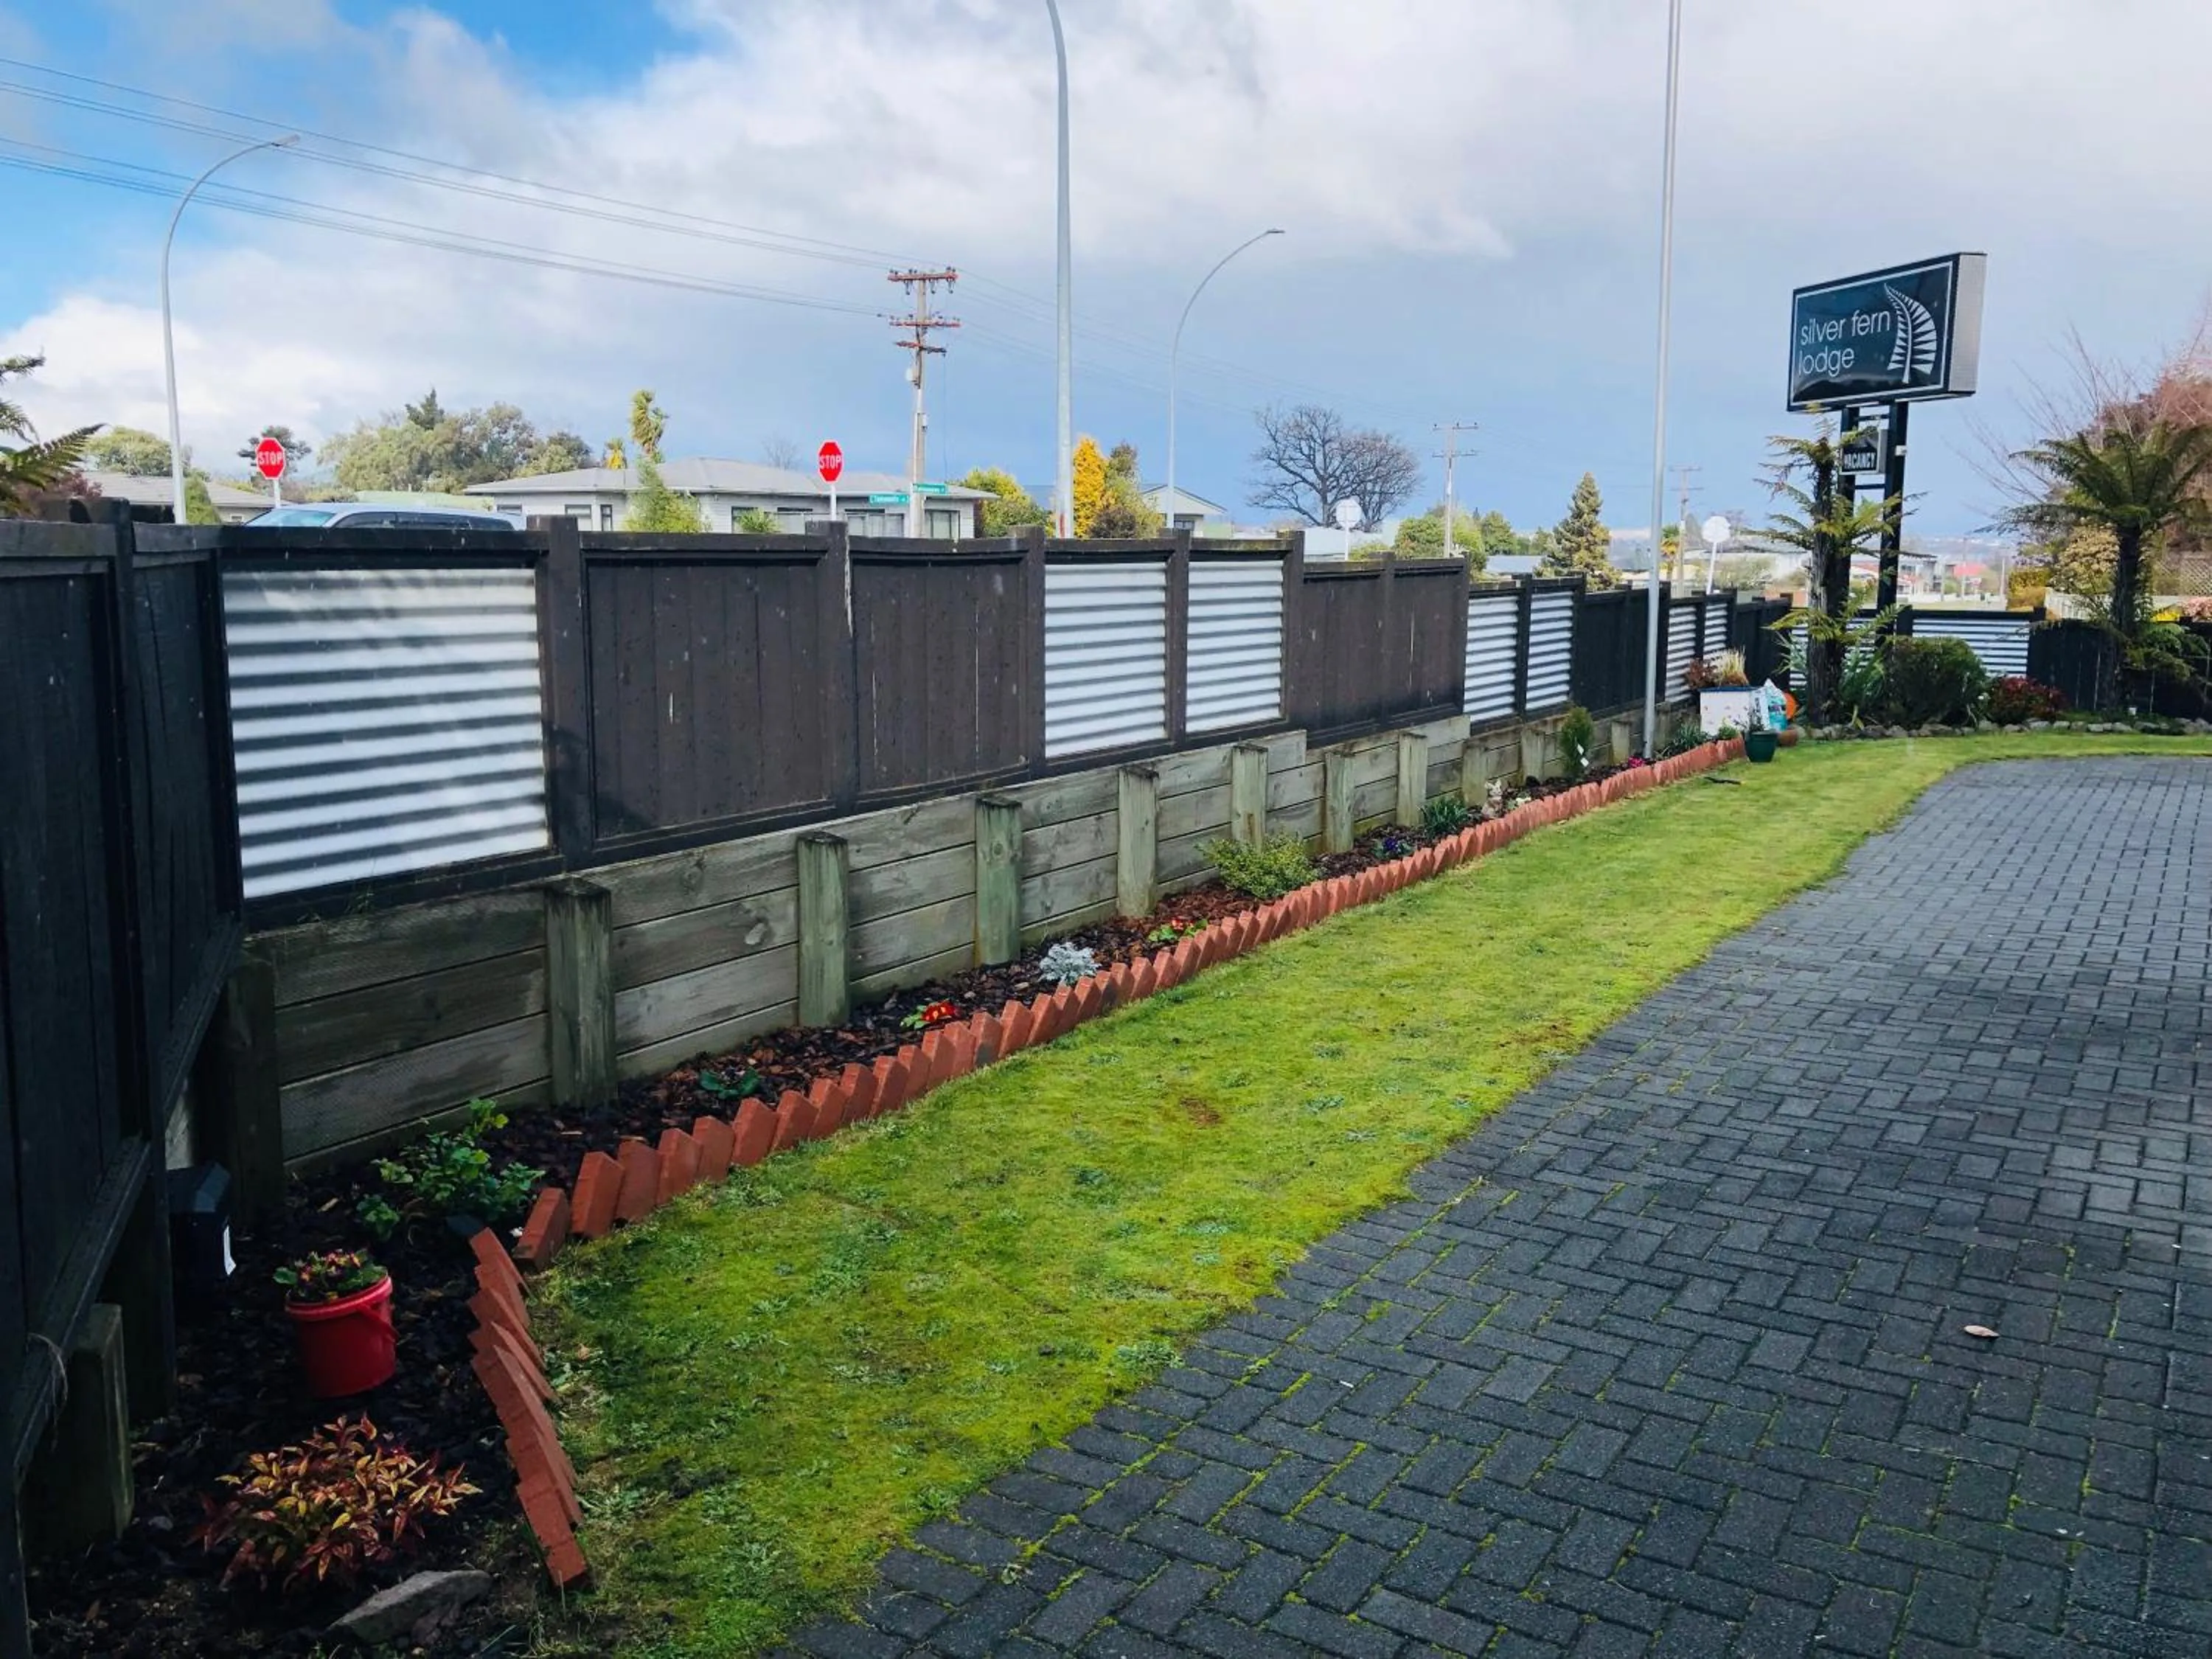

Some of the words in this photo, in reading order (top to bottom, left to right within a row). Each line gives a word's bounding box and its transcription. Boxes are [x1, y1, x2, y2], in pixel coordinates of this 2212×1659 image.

[1800, 318, 1846, 346] silver
[1851, 310, 1890, 337] fern
[1798, 346, 1854, 378] lodge
[259, 451, 283, 465] STOP
[819, 454, 841, 470] STOP
